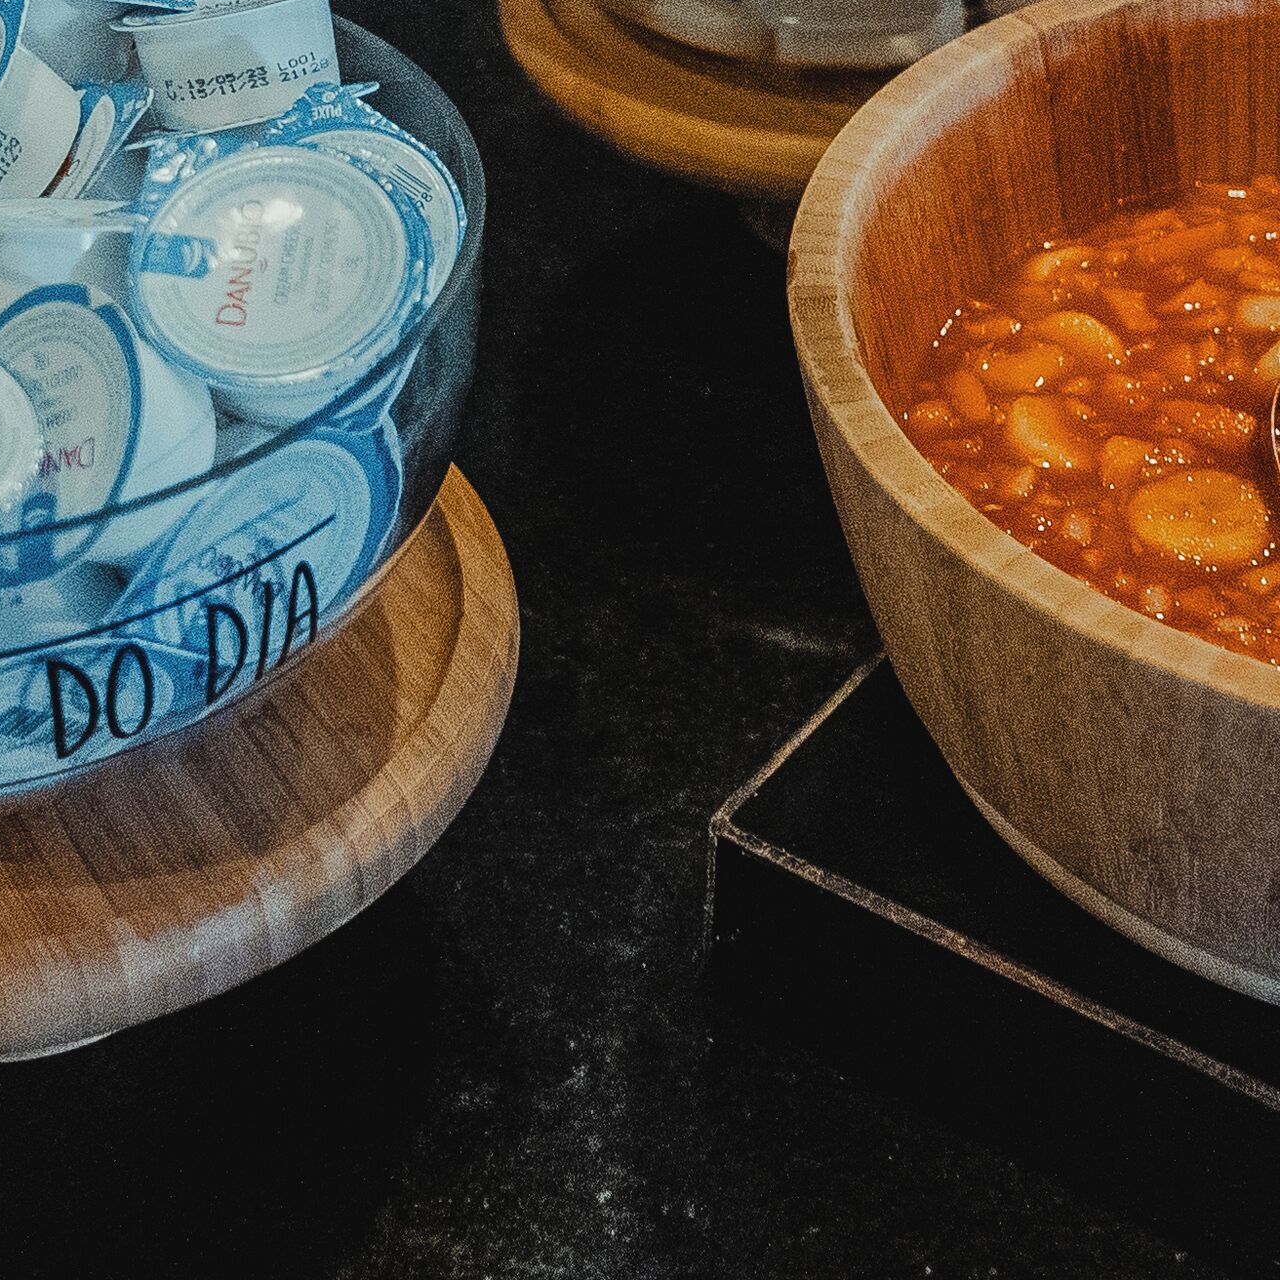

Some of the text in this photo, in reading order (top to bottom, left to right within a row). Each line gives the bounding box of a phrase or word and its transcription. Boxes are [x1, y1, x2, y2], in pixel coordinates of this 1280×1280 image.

[215, 198, 265, 328] DANUBIO
[46, 642, 154, 760] DO
[205, 560, 320, 705] DIA
